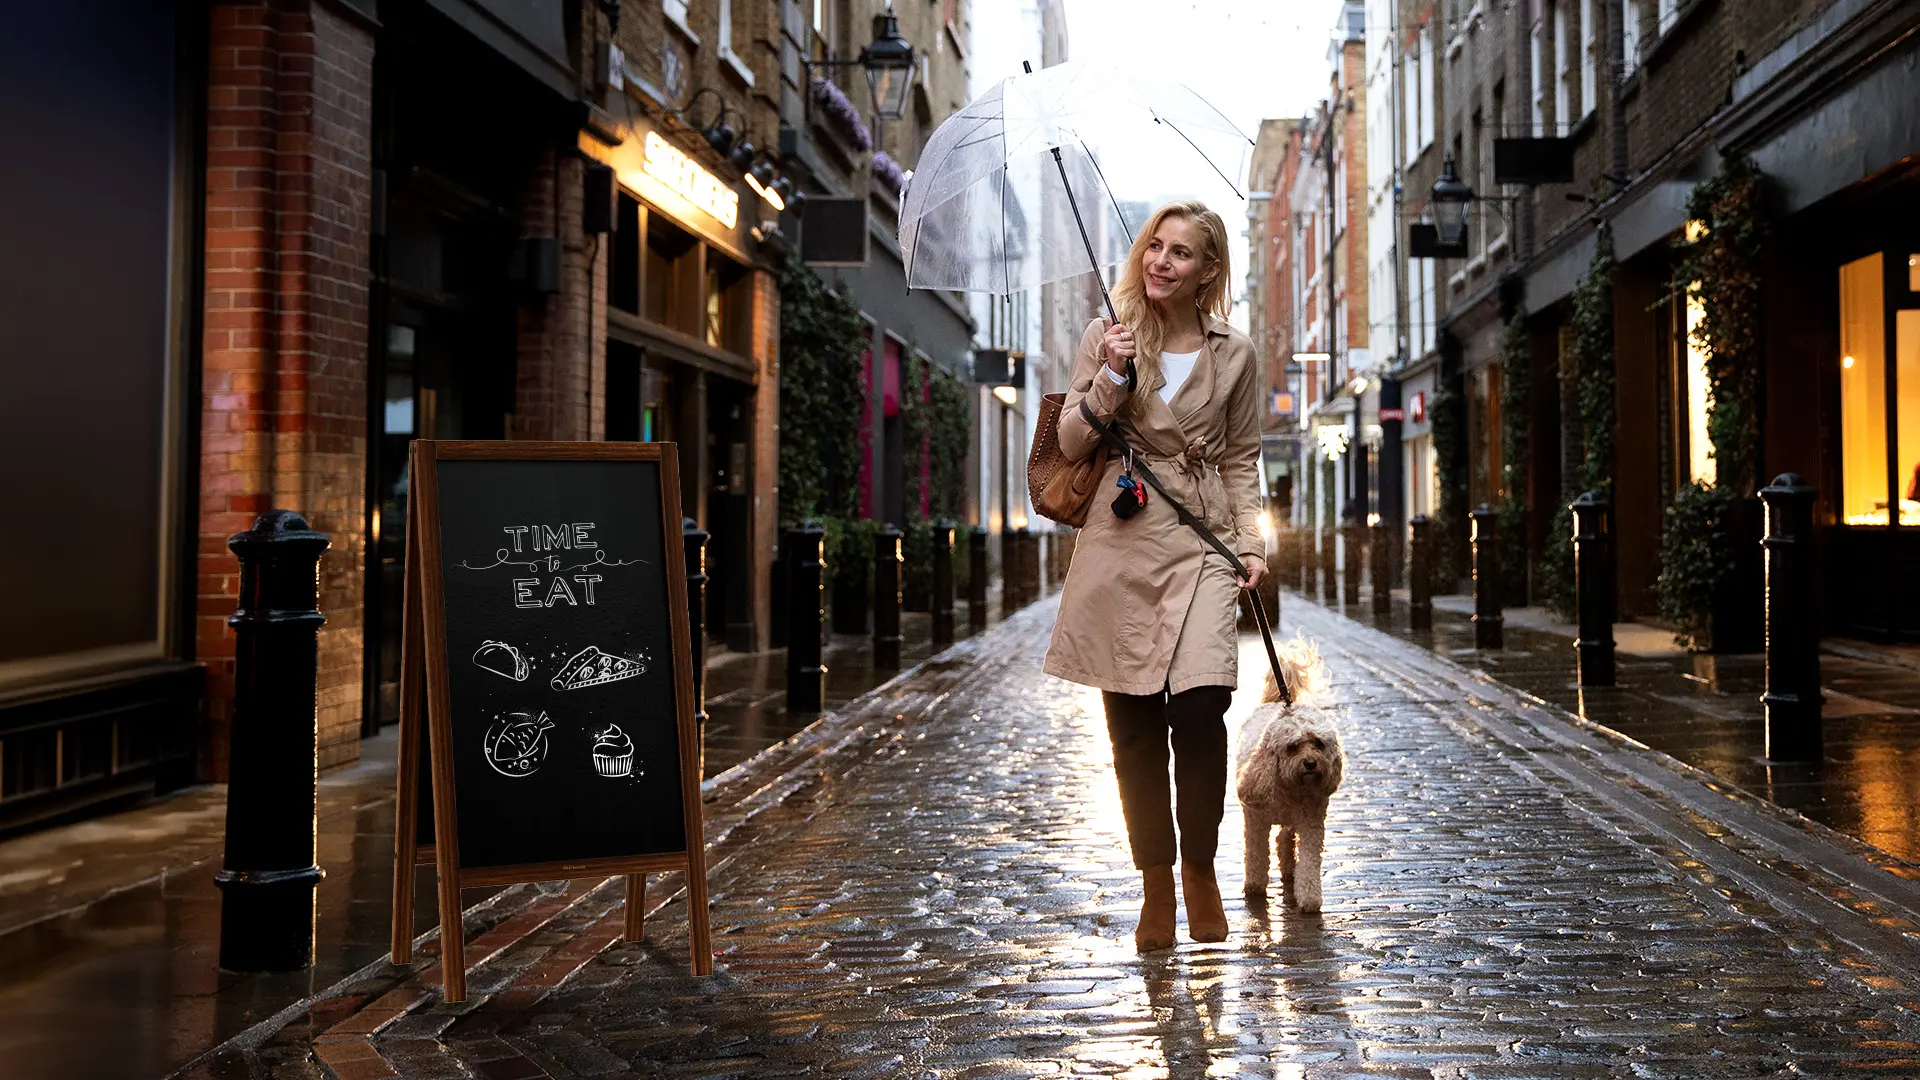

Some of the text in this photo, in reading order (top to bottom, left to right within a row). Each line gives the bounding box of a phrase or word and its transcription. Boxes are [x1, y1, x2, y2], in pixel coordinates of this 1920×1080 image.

[503, 522, 598, 552] TIME
[545, 555, 560, 572] to
[513, 574, 602, 608] EAT
